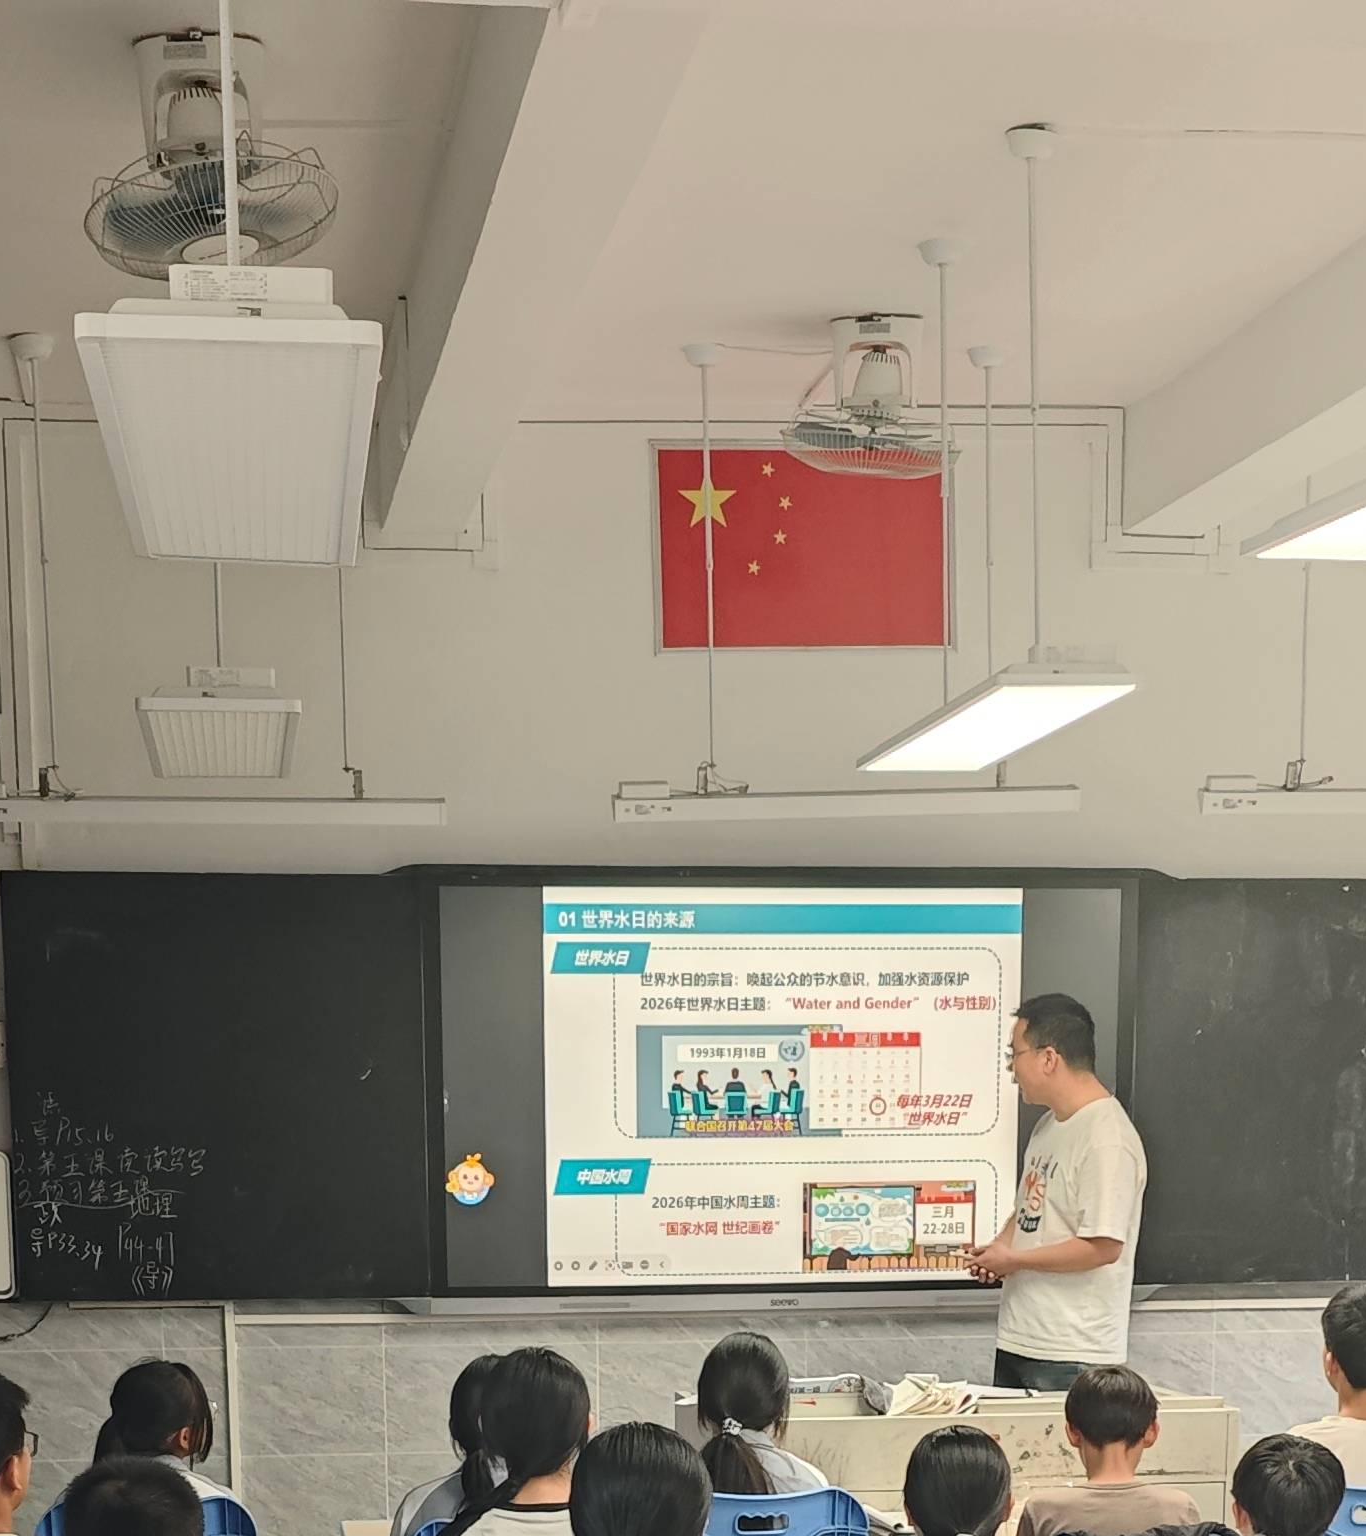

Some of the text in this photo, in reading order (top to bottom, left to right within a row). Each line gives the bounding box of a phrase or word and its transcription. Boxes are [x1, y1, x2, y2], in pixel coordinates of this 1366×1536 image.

[558, 909, 695, 929] 01 世界水日的来源
[574, 949, 630, 967] 世界水日
[835, 996, 861, 1010] and
[689, 1046, 767, 1059] 1993年1月18日
[896, 1094, 973, 1110] 每年3月22日
[576, 1168, 633, 1185] 中国水周
[931, 1205, 955, 1219] 三月
[922, 1222, 965, 1235] 22-28日
